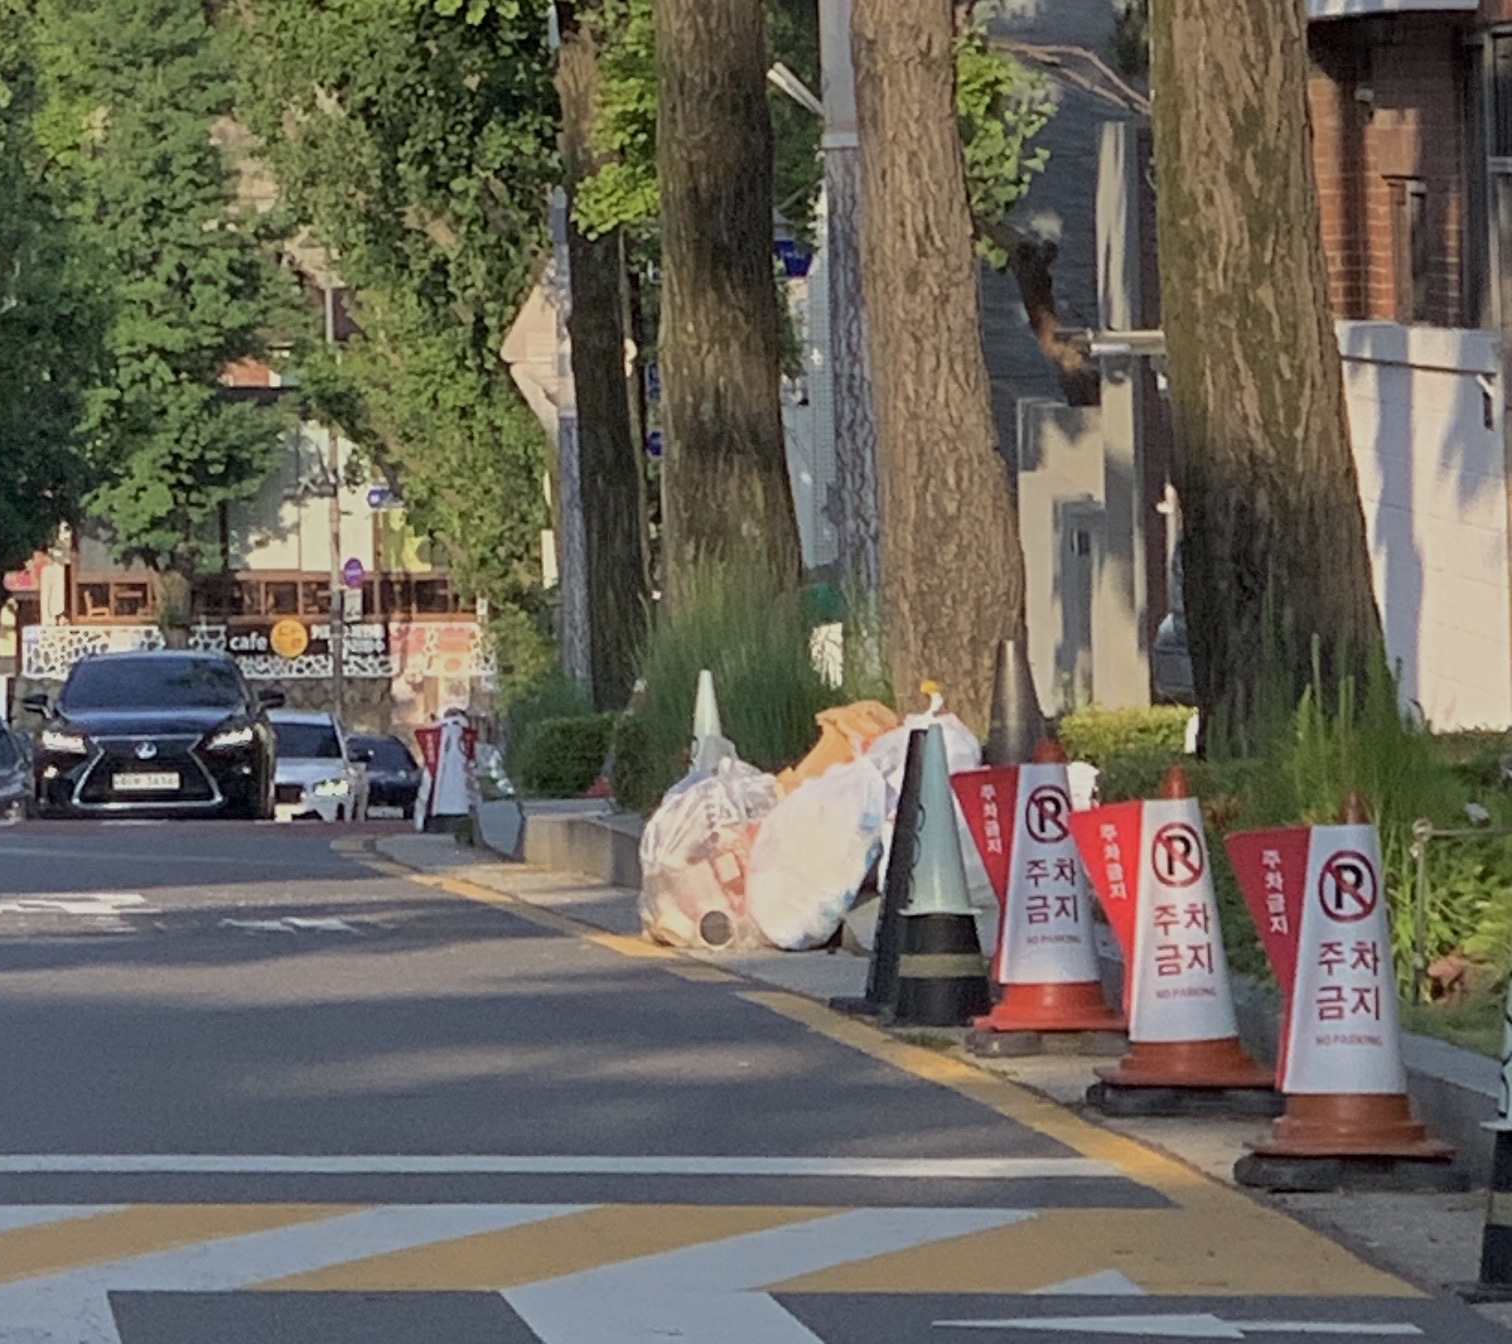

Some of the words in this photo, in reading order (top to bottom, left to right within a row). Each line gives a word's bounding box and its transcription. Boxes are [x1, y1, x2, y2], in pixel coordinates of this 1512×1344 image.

[229, 631, 268, 651] cafe
[1025, 857, 1077, 888] 주차
[1025, 894, 1079, 924] 금지
[1262, 849, 1288, 935] 주차금지
[1153, 902, 1211, 935] 주차
[1154, 942, 1215, 977] 금지
[1318, 940, 1381, 977] 주차
[1316, 985, 1381, 1022] 금지
